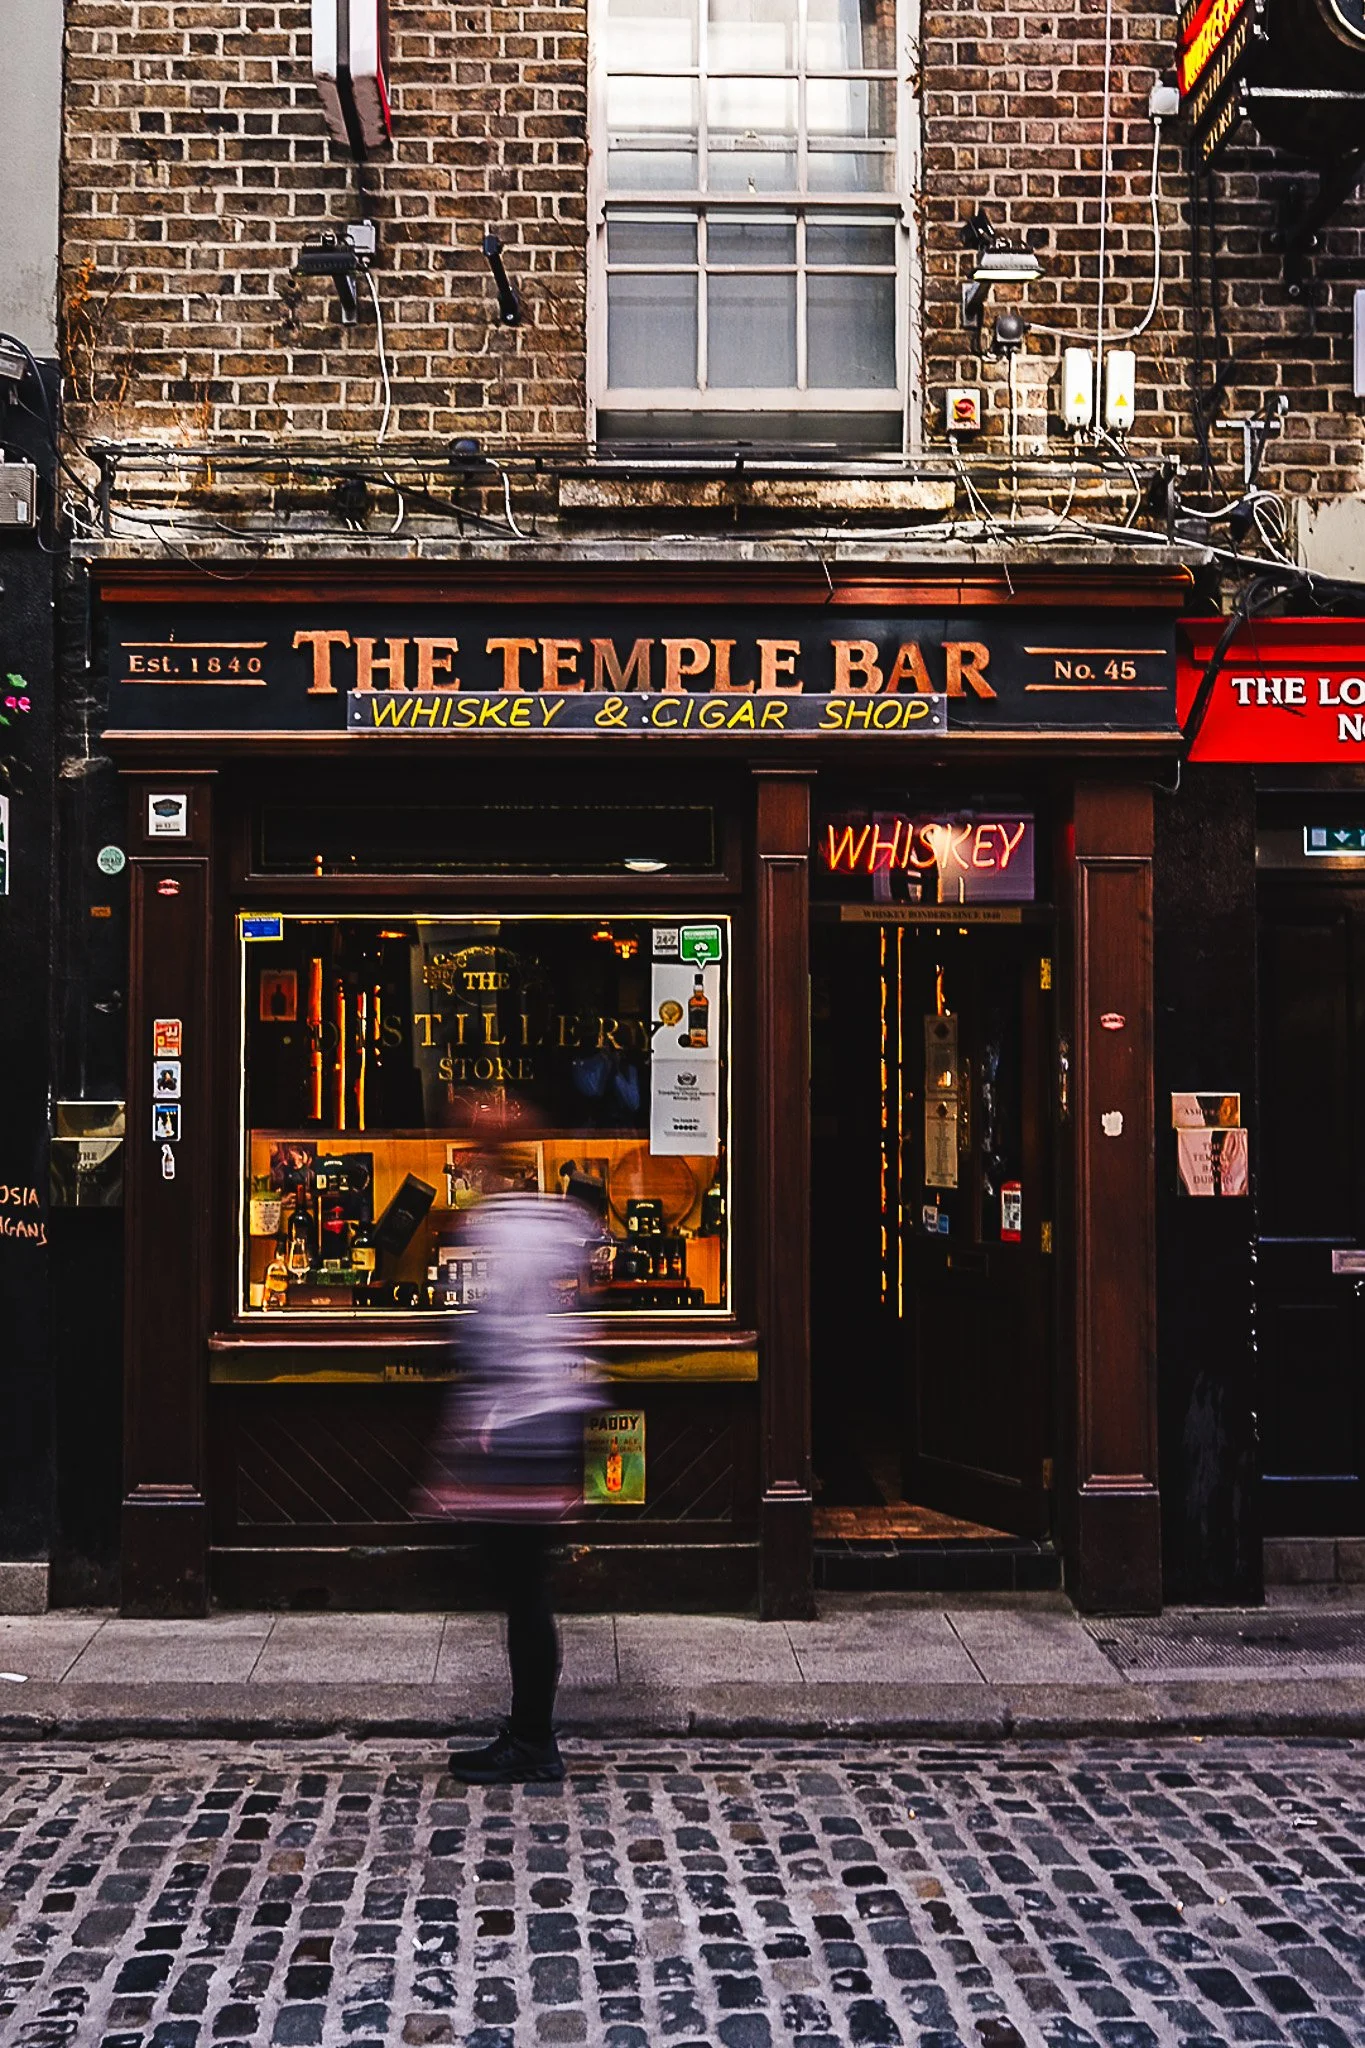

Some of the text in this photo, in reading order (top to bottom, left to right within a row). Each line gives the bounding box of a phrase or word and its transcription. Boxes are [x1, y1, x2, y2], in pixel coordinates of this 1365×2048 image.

[128, 655, 263, 674] Est. 1840
[292, 630, 997, 699] THE TEMPLE BAR
[1053, 660, 1138, 681] No. 45
[1231, 677, 1307, 706] THE
[371, 696, 930, 731] WHISKEY & CIGAR SHOP
[827, 819, 1025, 872] WHISKEY
[462, 972, 510, 991] THE
[438, 1057, 535, 1080] STORE
[590, 1415, 640, 1431] PADDY
